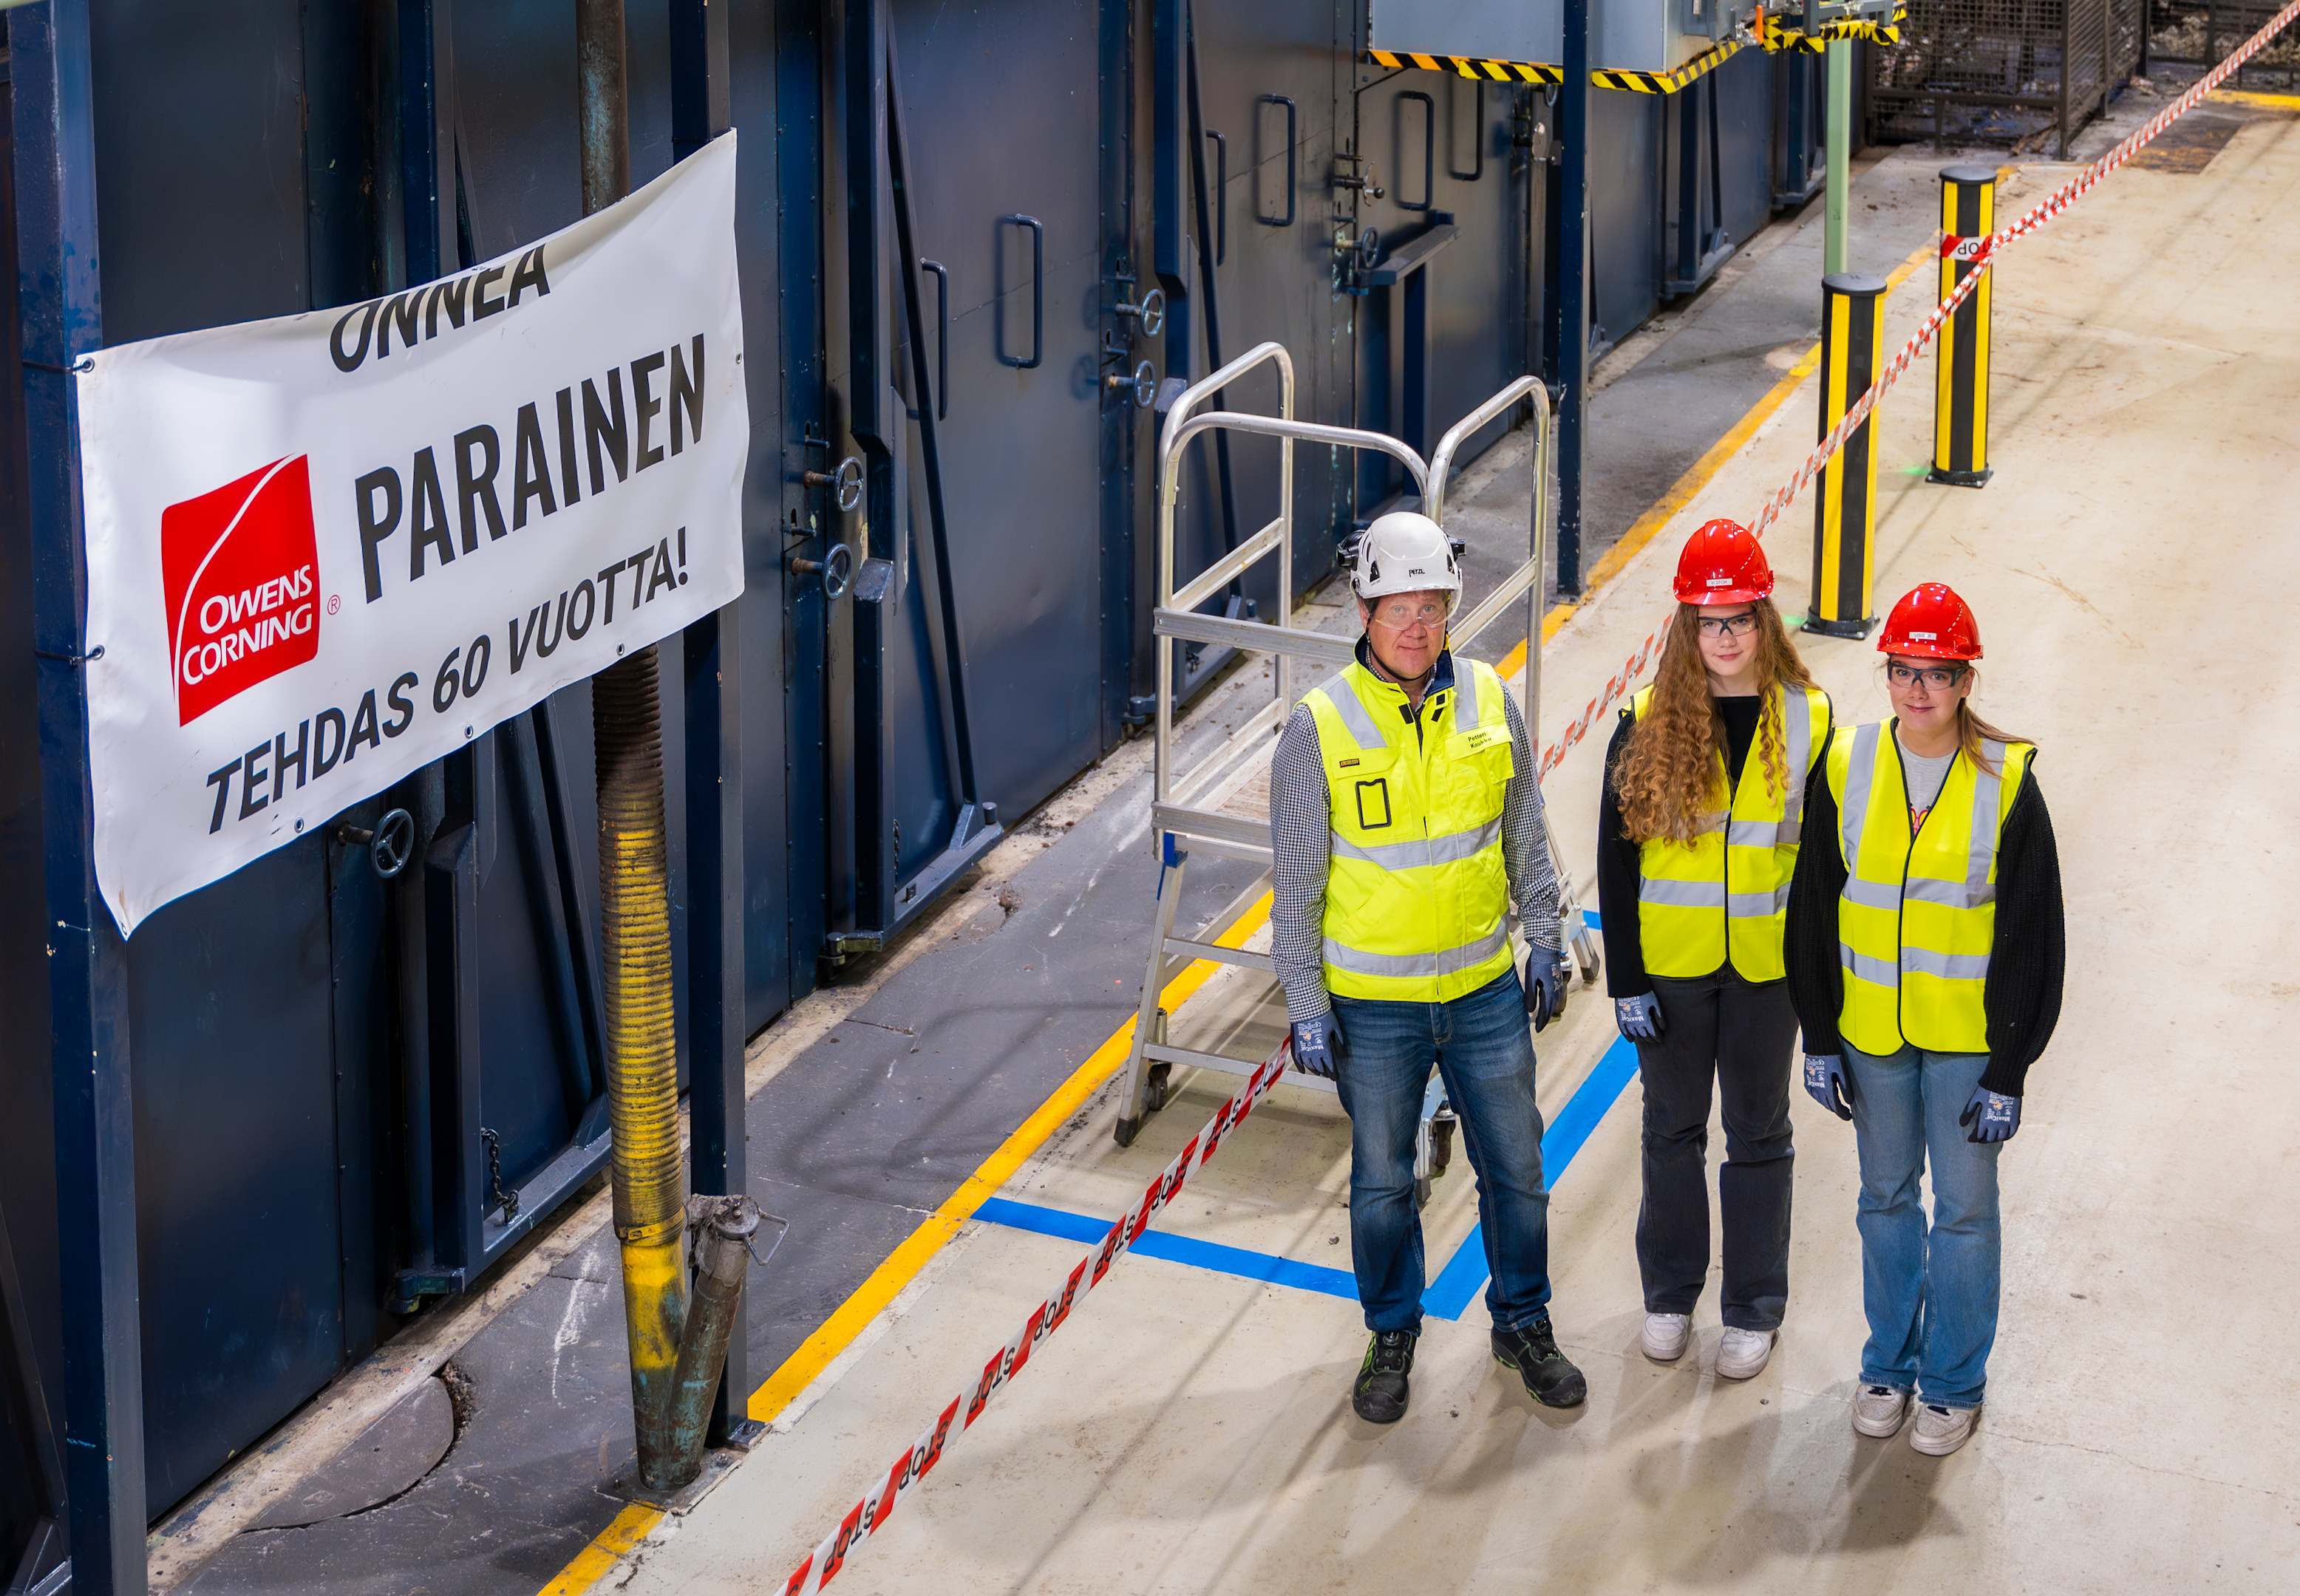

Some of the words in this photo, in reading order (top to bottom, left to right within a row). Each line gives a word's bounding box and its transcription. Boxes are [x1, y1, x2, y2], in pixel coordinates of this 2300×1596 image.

[330, 243, 551, 372] ONNEA
[355, 332, 705, 604] PARAINEN
[200, 564, 313, 635] OWENS
[1409, 568, 1425, 578] PETZL
[183, 602, 313, 686] CORNING
[205, 671, 419, 836] TEHDAS
[432, 634, 491, 714] 60
[508, 525, 688, 675] VUOTTA!
[1151, 1155, 1191, 1211] STOP
[1093, 1214, 1136, 1275] STOP
[1033, 1279, 1078, 1342] STOP
[968, 1347, 1015, 1413] STOP
[897, 1419, 949, 1491] STOP
[823, 1498, 877, 1574] STOP
